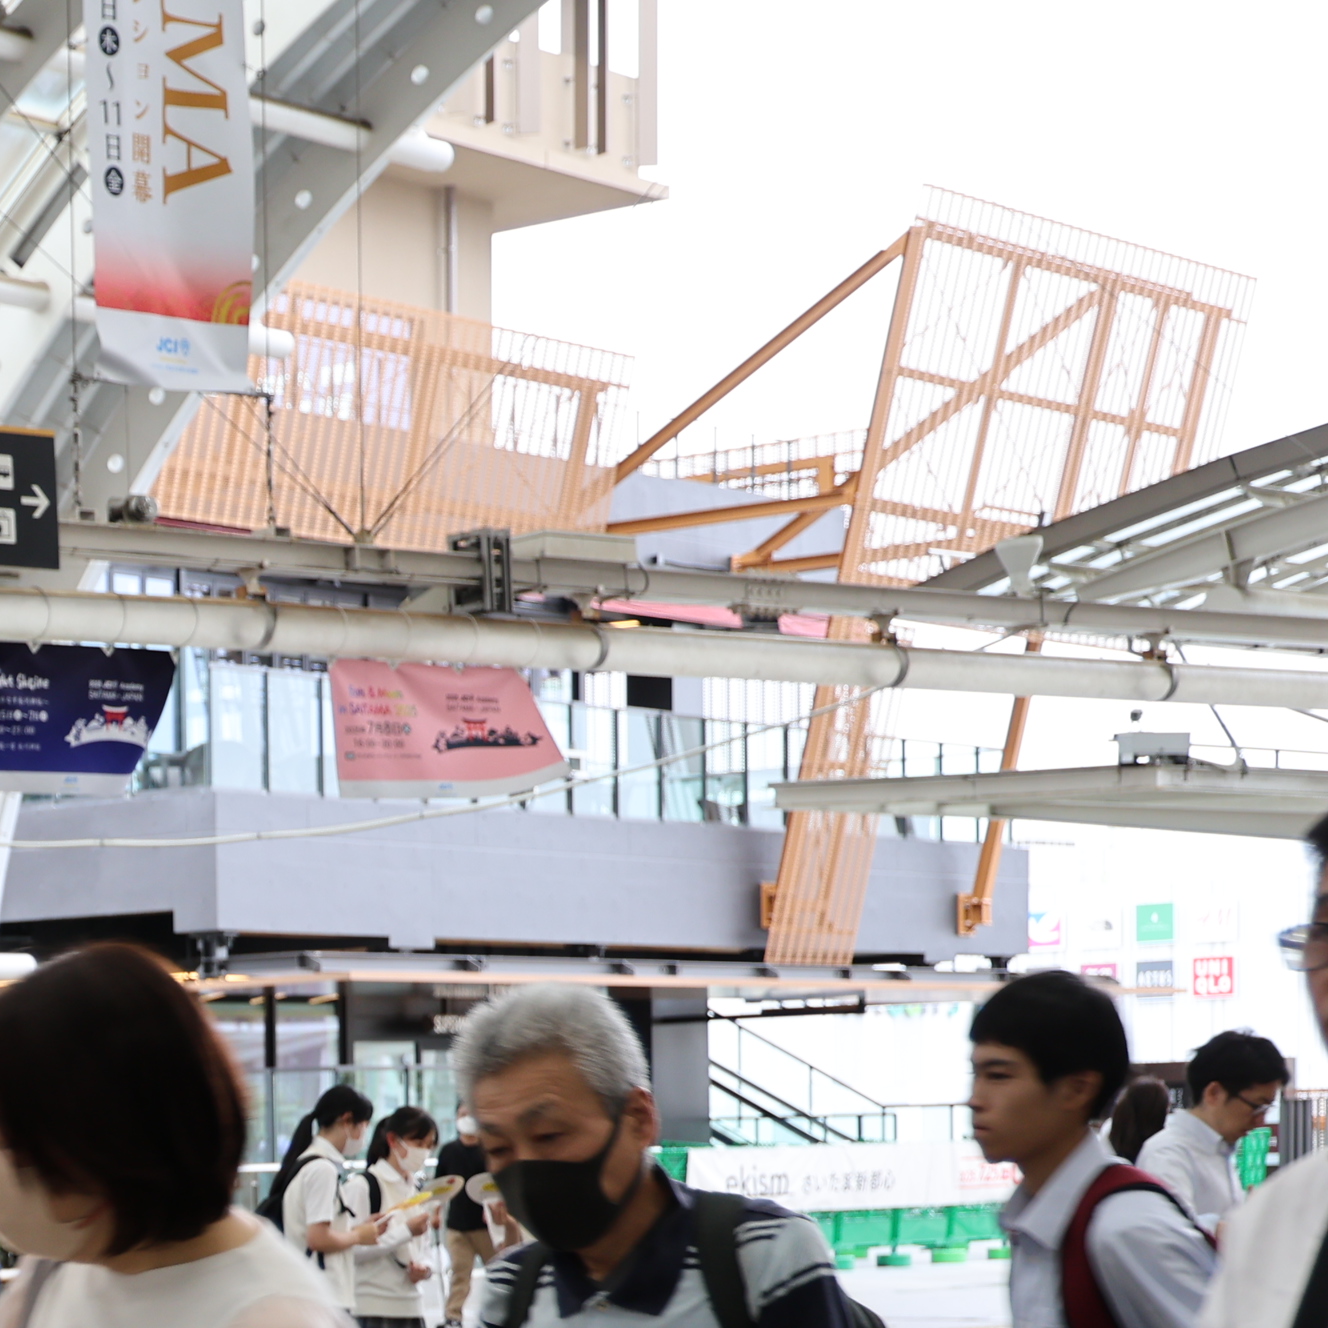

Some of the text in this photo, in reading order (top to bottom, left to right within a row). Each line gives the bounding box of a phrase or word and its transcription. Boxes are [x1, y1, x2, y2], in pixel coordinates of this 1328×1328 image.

[161, 0, 233, 205] MA
[1195, 958, 1229, 977] UNI
[1195, 975, 1232, 996] QLO
